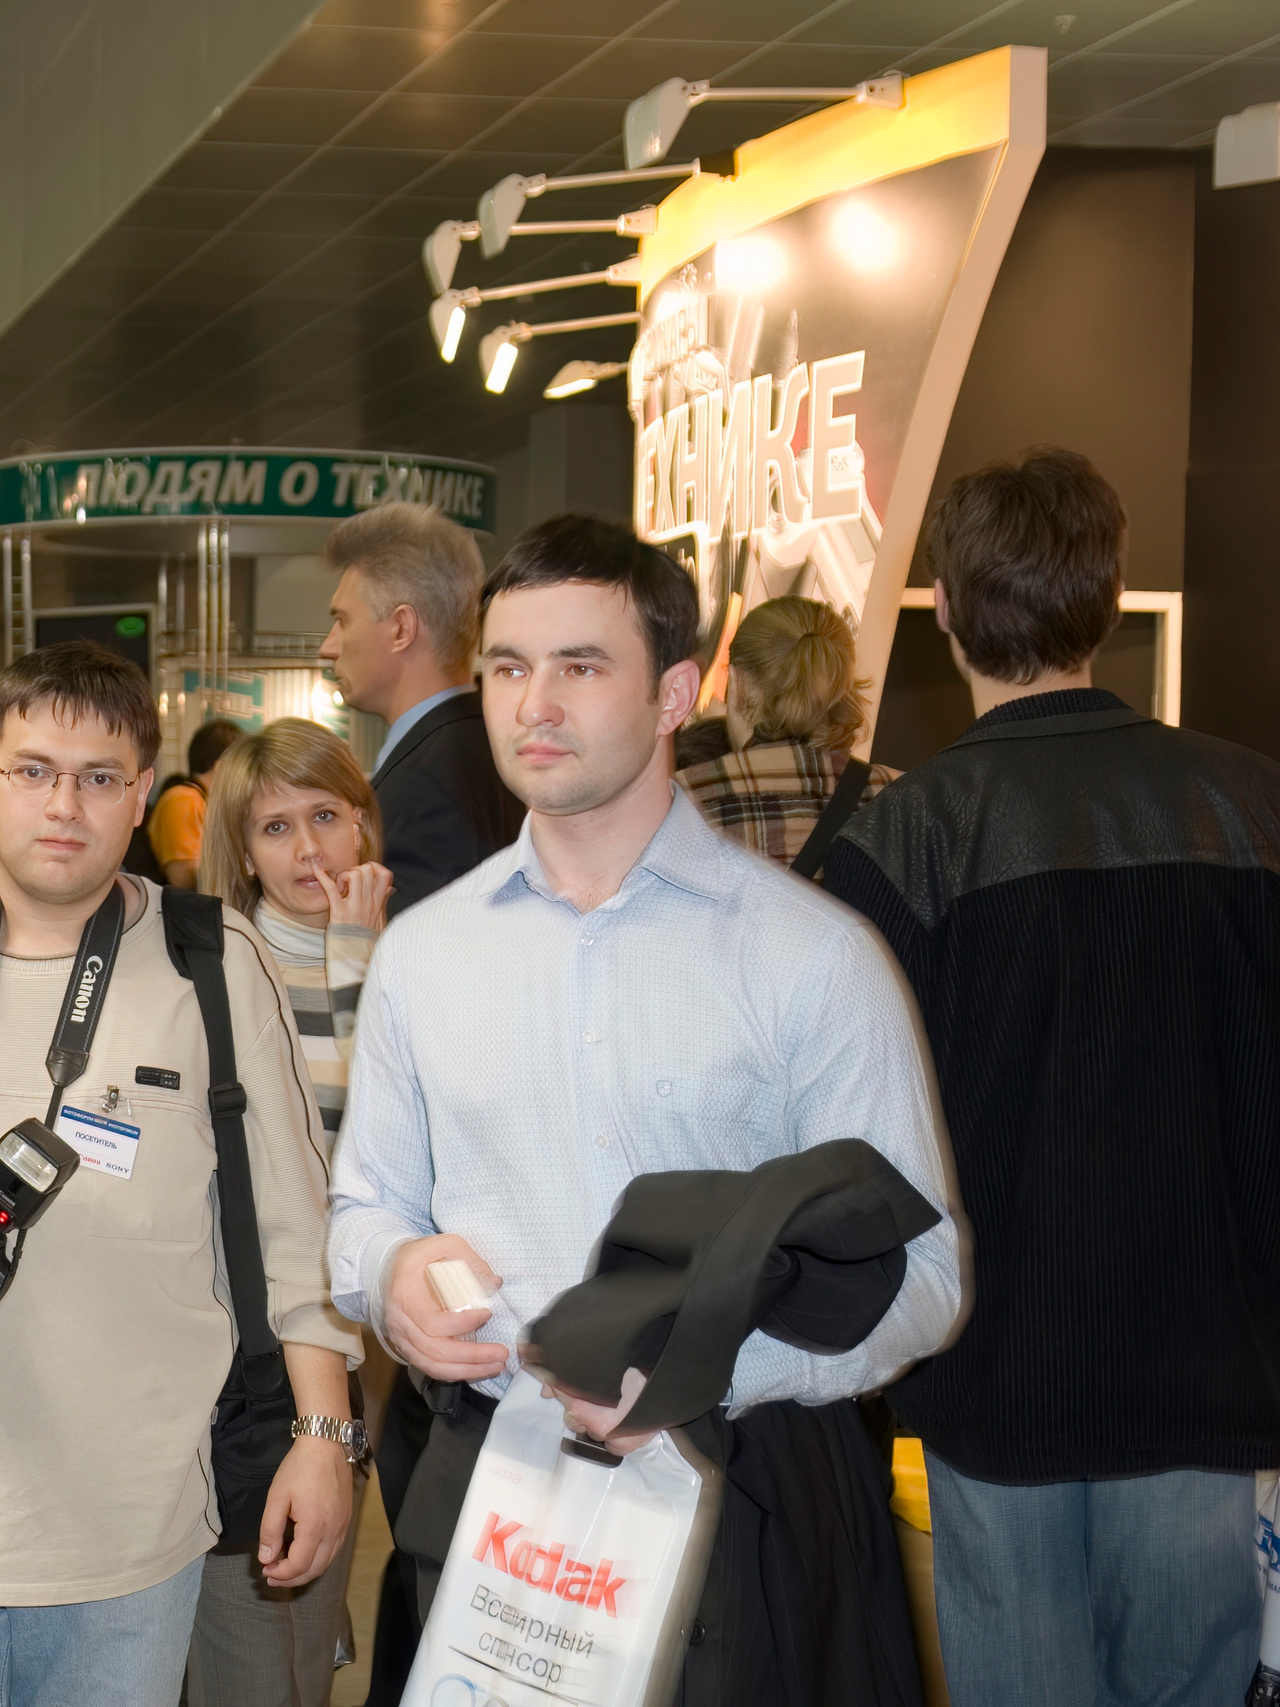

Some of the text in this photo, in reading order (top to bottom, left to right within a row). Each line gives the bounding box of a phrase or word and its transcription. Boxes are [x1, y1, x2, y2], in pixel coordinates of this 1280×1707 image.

[637, 350, 865, 541] ЕХНИКЕ
[72, 459, 484, 518] ЛЮДЯМ О ТЕХНИКЕ
[70, 955, 104, 1024] Canon
[75, 1131, 118, 1150] ПОСЕТИТЕЛЬ
[105, 1162, 130, 1174] SONY
[471, 1510, 627, 1619] Kodak
